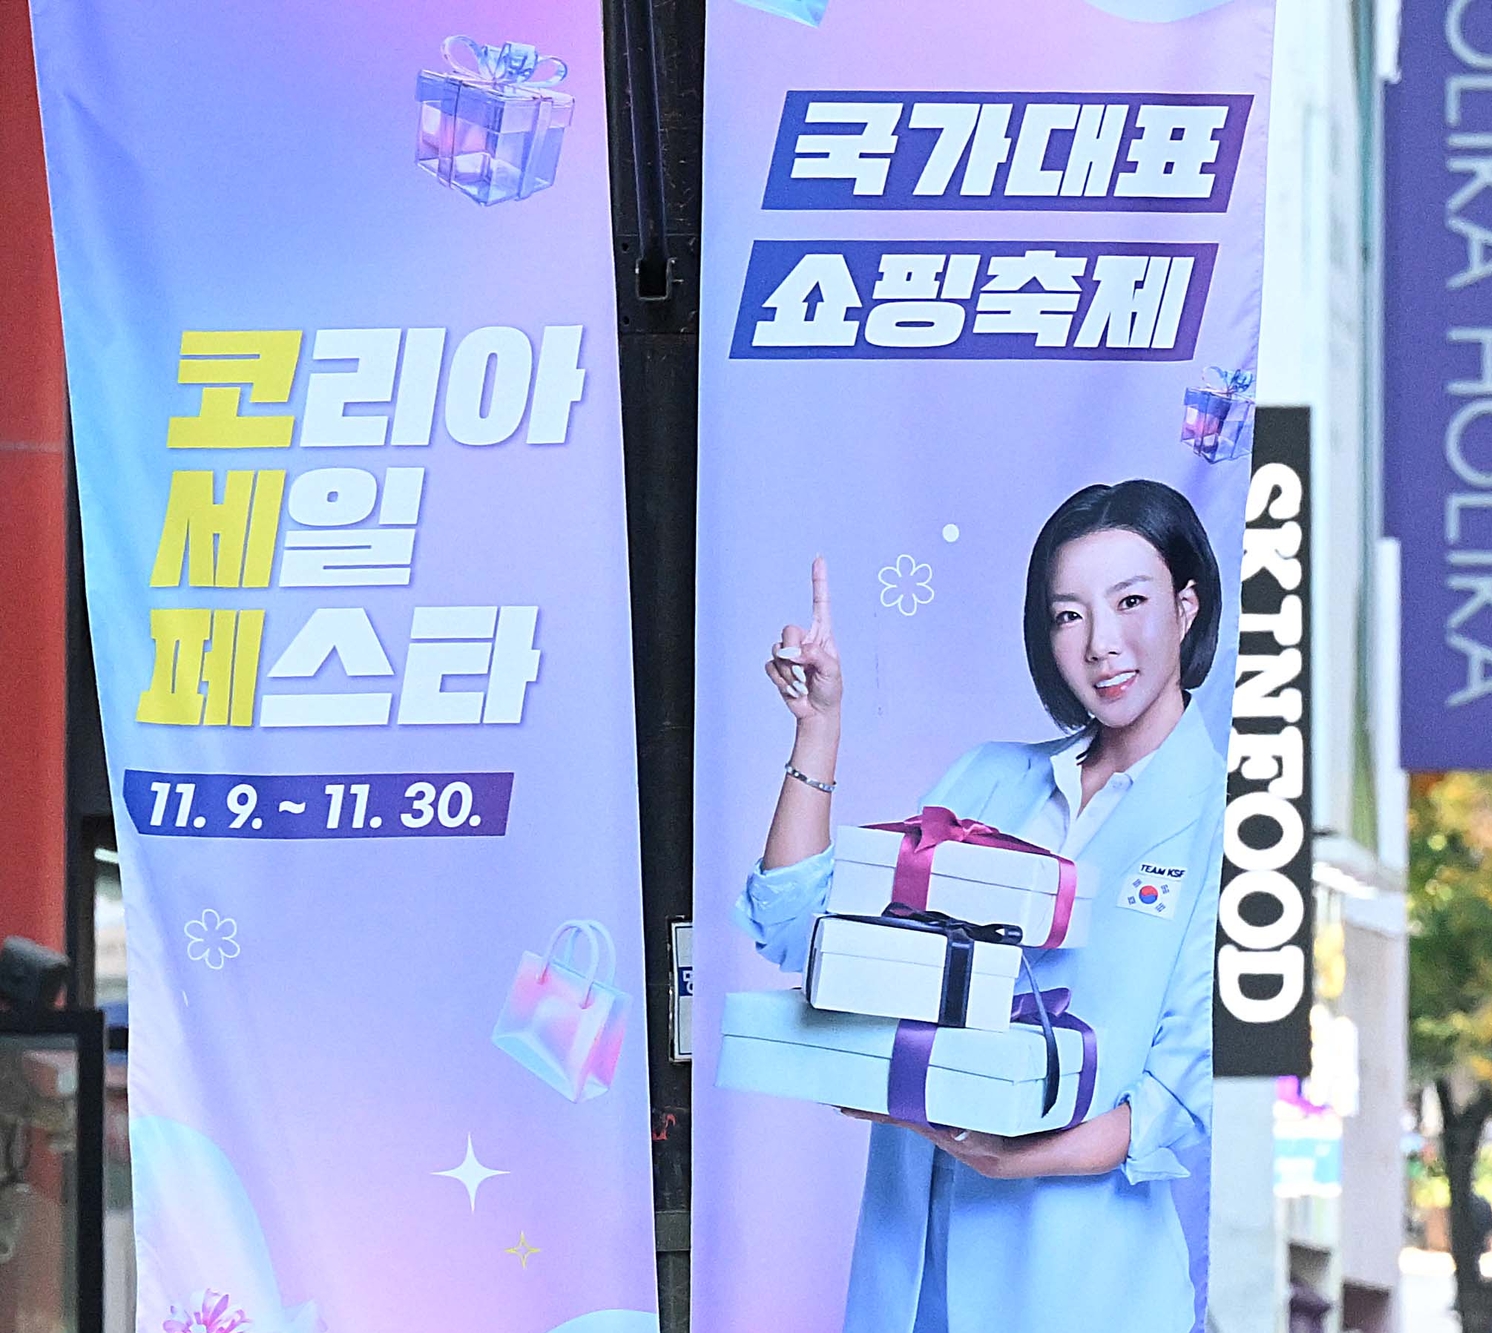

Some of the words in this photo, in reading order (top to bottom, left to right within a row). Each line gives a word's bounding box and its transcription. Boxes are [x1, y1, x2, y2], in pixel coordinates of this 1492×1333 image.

[791, 102, 1228, 198] 국가대표
[752, 251, 1195, 348] 쇼핑축제
[167, 326, 585, 448] 코리아
[150, 467, 424, 587] 세일
[136, 606, 542, 727] 페스타
[1218, 462, 1304, 1023] SKINFOOD
[401, 783, 482, 828] 30.
[1140, 864, 1166, 876] TEAM
[1167, 868, 1186, 878] KSF
